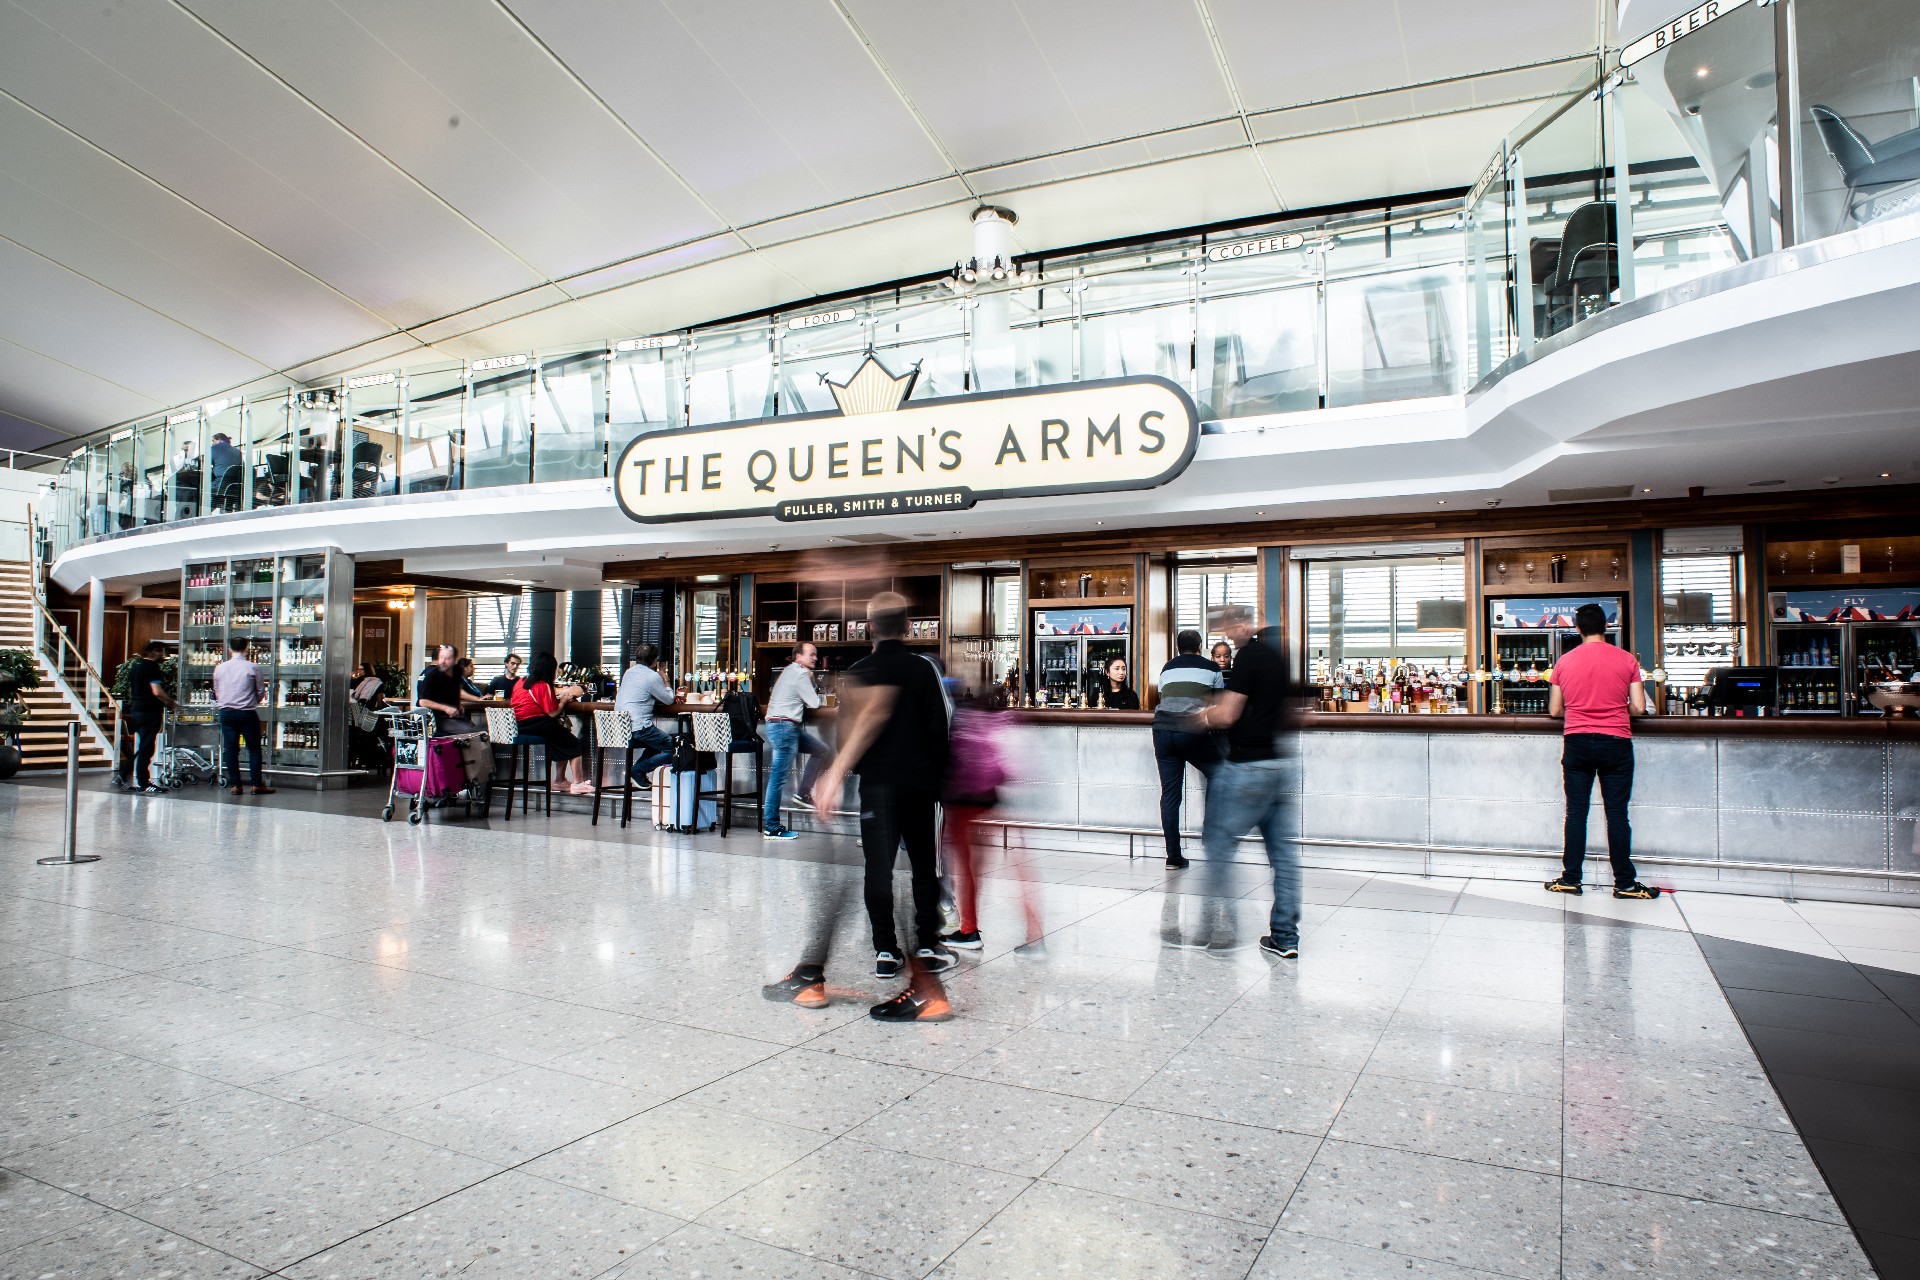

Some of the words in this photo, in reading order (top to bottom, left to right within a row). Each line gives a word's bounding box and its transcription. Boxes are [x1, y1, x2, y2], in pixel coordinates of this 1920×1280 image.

[1655, 1, 1719, 49] BEER
[1220, 237, 1290, 259] COFFEE
[804, 312, 840, 327] FOOD
[634, 337, 664, 350] BEER
[483, 356, 516, 368] WINES
[633, 452, 722, 496] THE
[747, 426, 963, 493] QUEEN'S
[994, 410, 1166, 466] ARMS
[784, 503, 838, 517] FULLER,
[843, 499, 885, 512] SMITH
[891, 498, 899, 508] &
[905, 493, 963, 507] TURNER
[1543, 606, 1577, 614] DRINK
